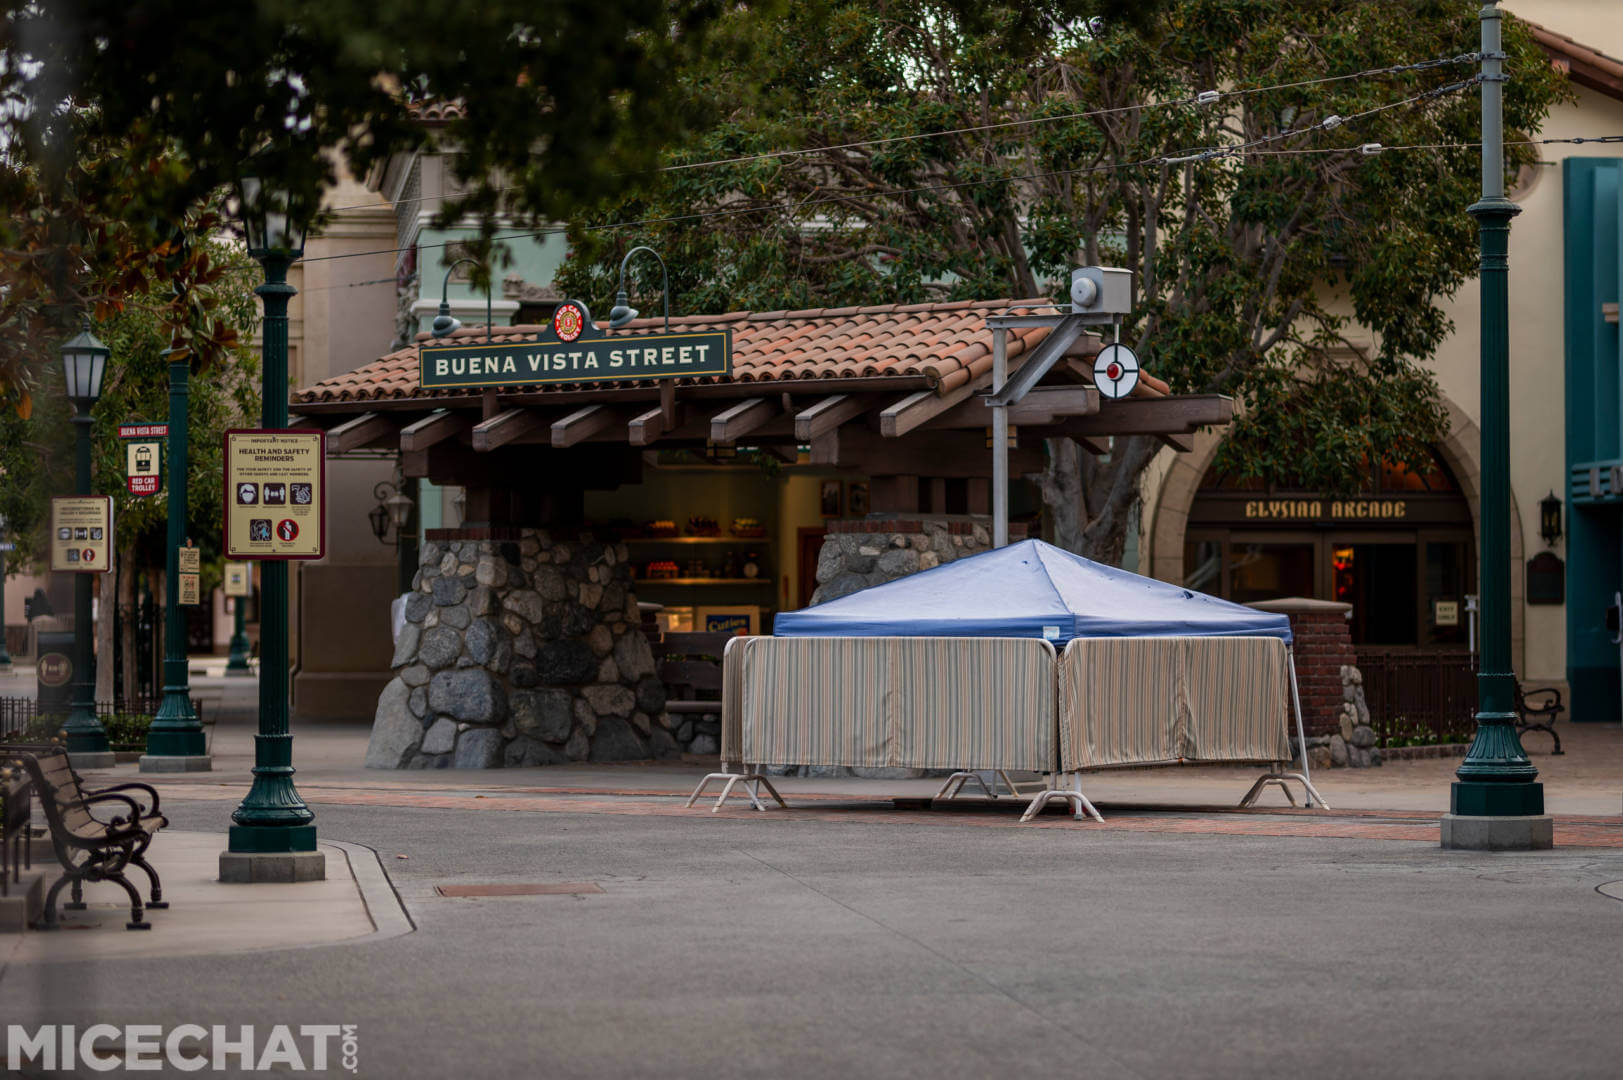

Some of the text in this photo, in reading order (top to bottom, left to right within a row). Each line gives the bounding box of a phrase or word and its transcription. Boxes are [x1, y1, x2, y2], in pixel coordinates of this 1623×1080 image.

[435, 345, 710, 376] BUENA VISTA STREET
[121, 425, 167, 436] BUENA VISTA STREET
[131, 477, 156, 485] RED CAR
[131, 484, 156, 492] TROLLEY
[1245, 501, 1406, 519] ELYSIAN ARCADE
